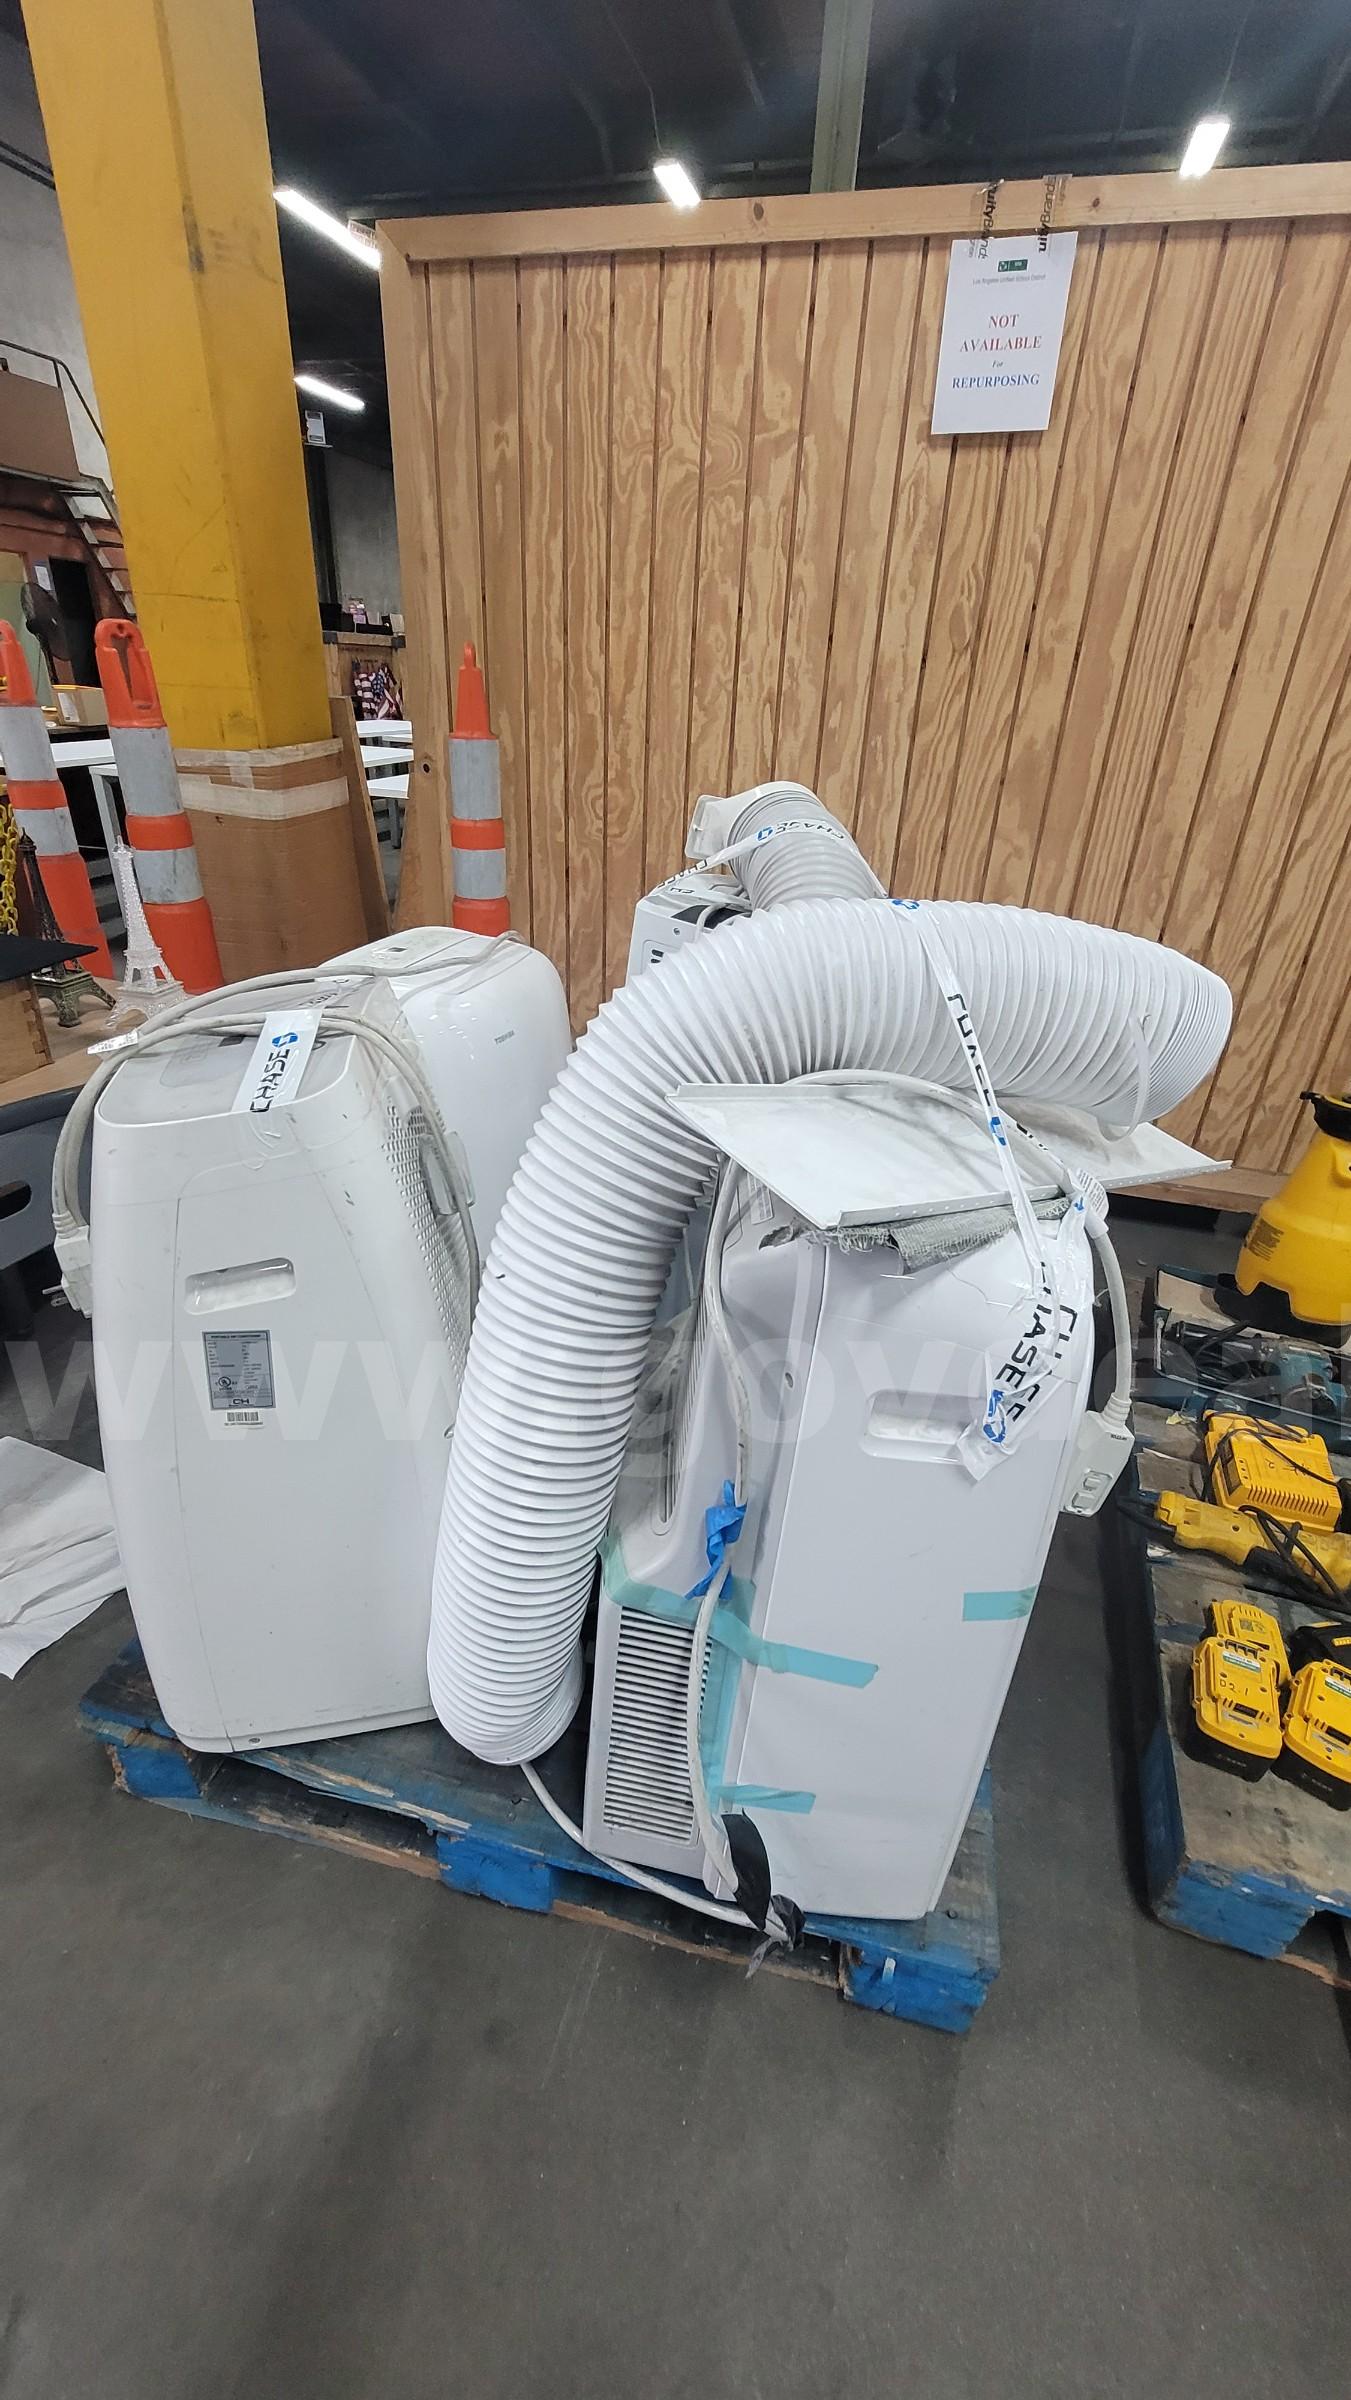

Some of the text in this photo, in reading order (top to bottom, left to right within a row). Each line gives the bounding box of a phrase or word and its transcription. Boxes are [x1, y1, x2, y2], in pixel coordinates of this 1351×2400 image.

[988, 314, 1020, 329] NOT
[960, 335, 1042, 353] AVAILABLE
[992, 360, 1004, 369] For
[952, 374, 1041, 389] REPURPOSING
[249, 1048, 291, 1113] CHASE
